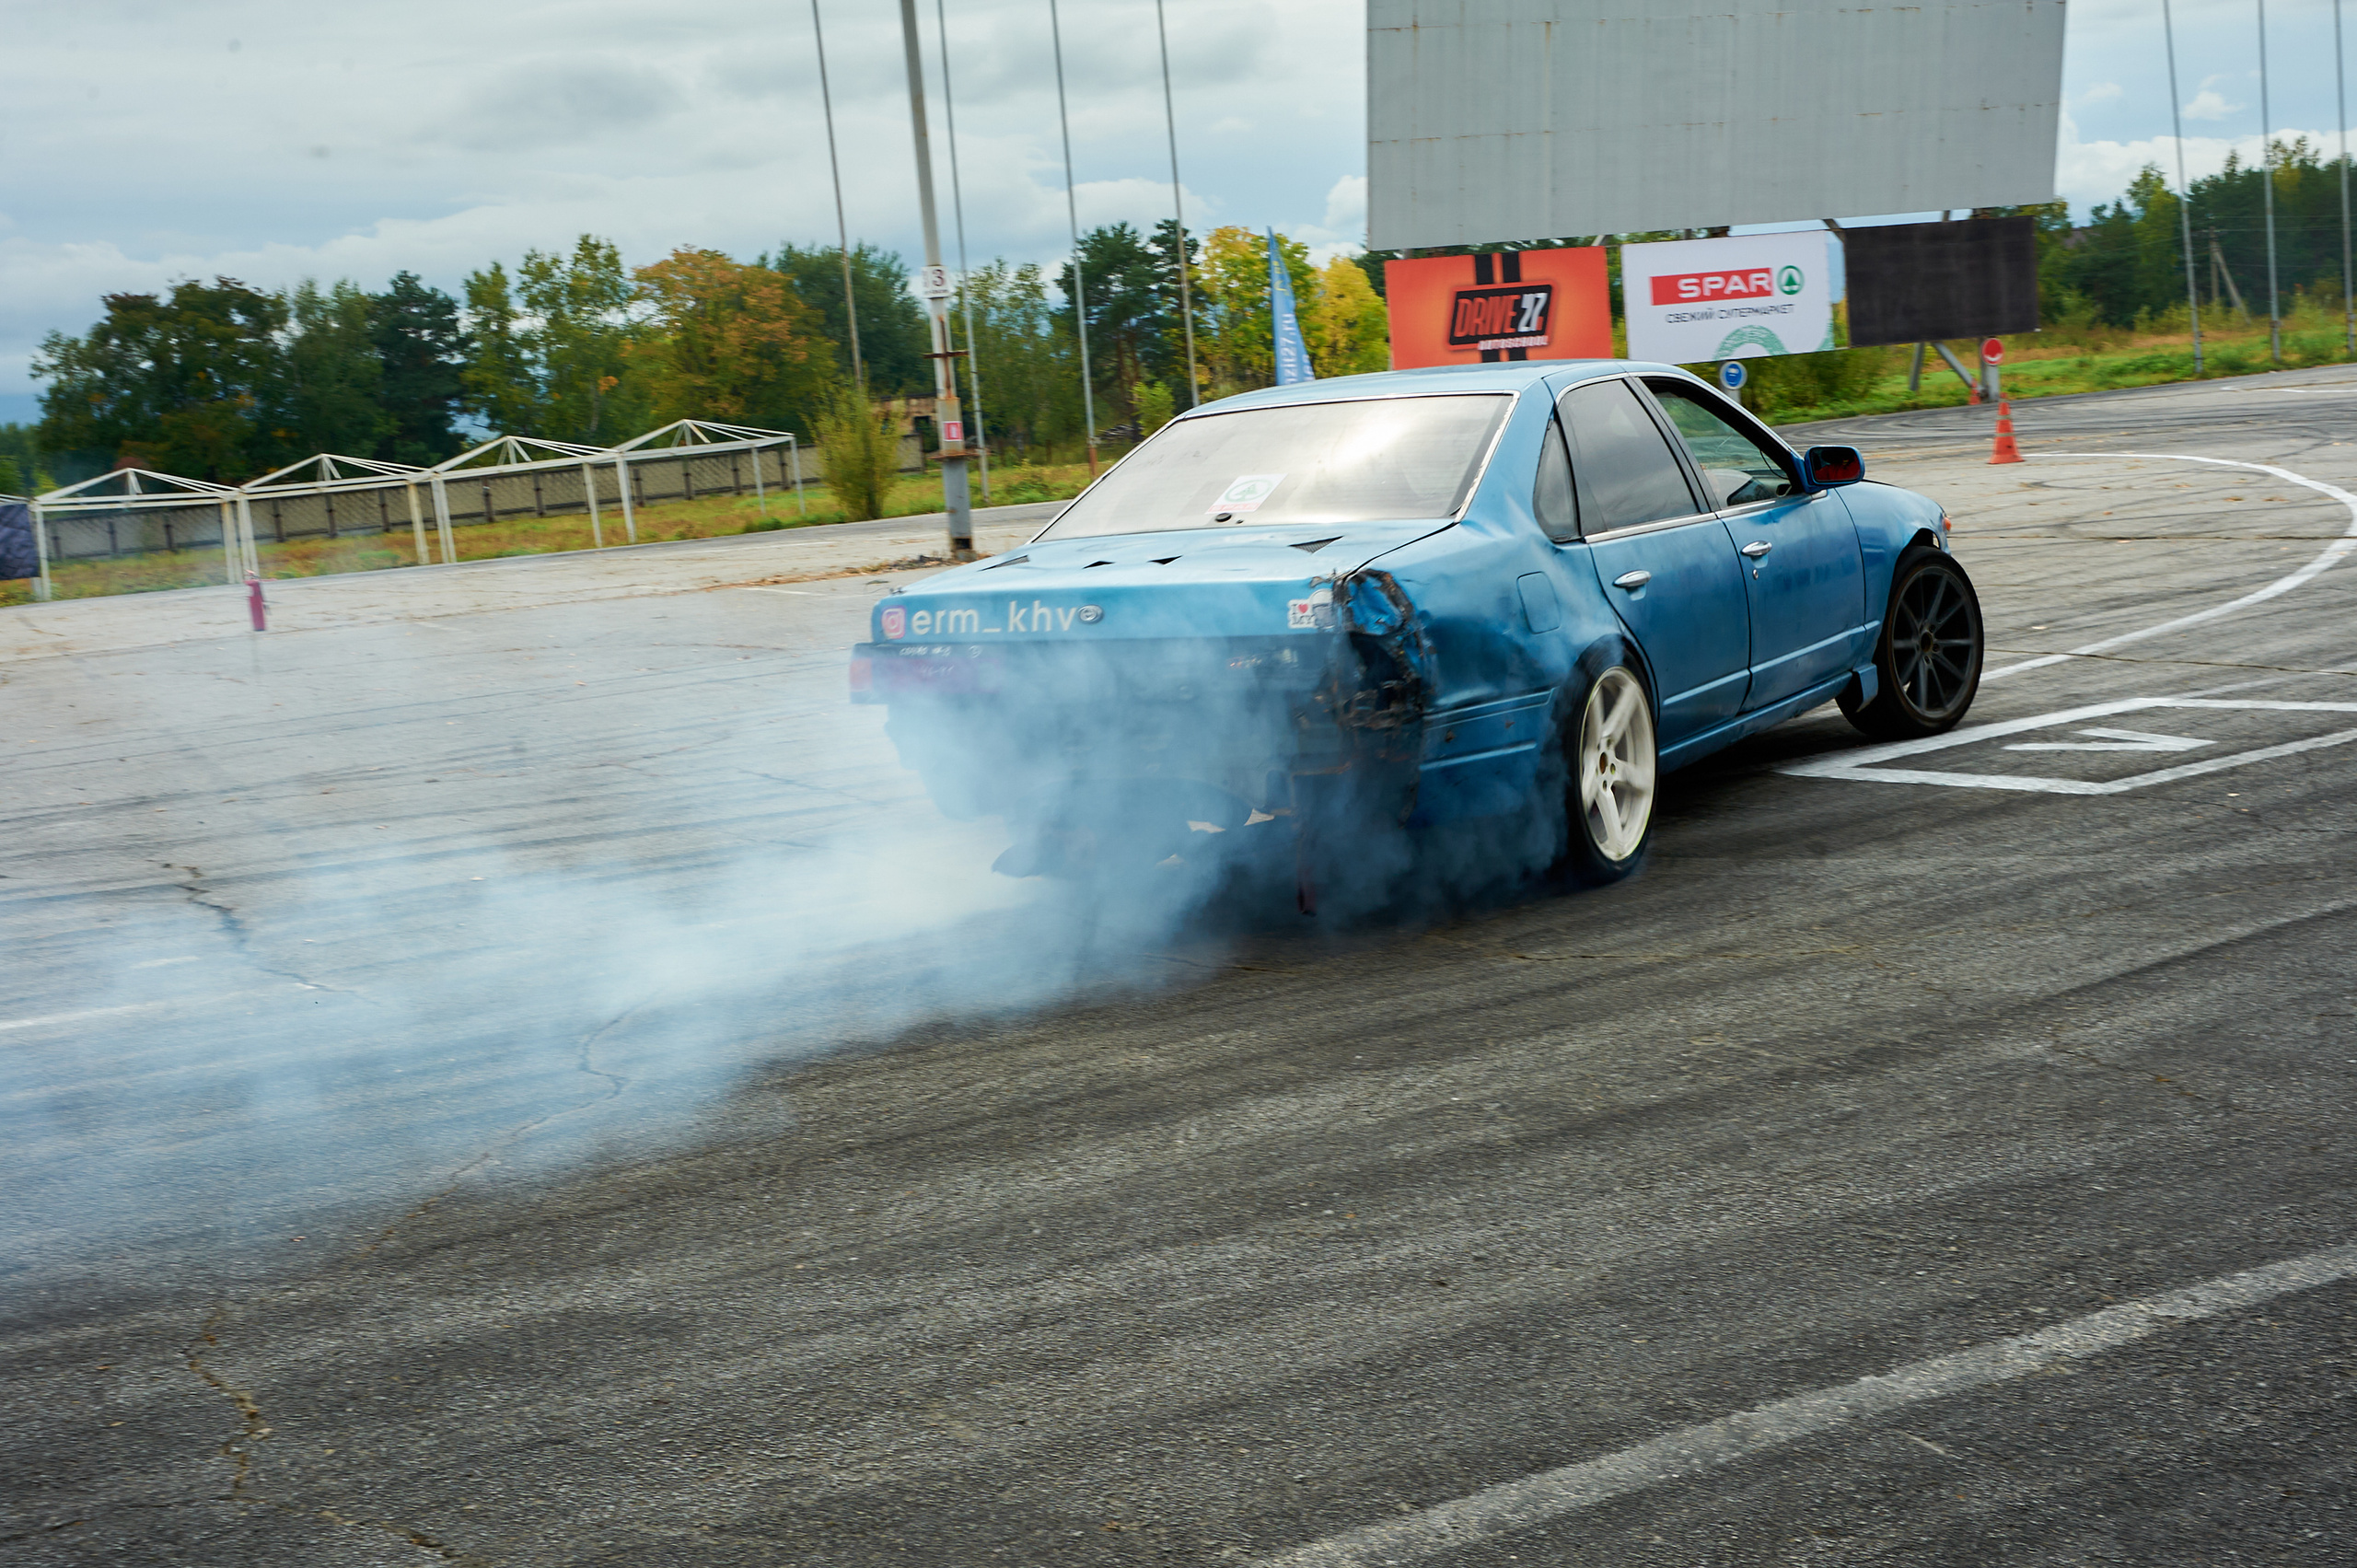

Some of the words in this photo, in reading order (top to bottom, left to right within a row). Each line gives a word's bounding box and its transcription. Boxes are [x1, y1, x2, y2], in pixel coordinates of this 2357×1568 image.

[1678, 273, 1772, 298] SPAR
[1454, 295, 1521, 337] DRIVE
[1517, 293, 1548, 332] 27
[1665, 308, 1713, 323] СВЕЖИЙ
[1718, 303, 1795, 319] СУПЕРМАРКЕТ
[911, 600, 1076, 635] erm_khv
